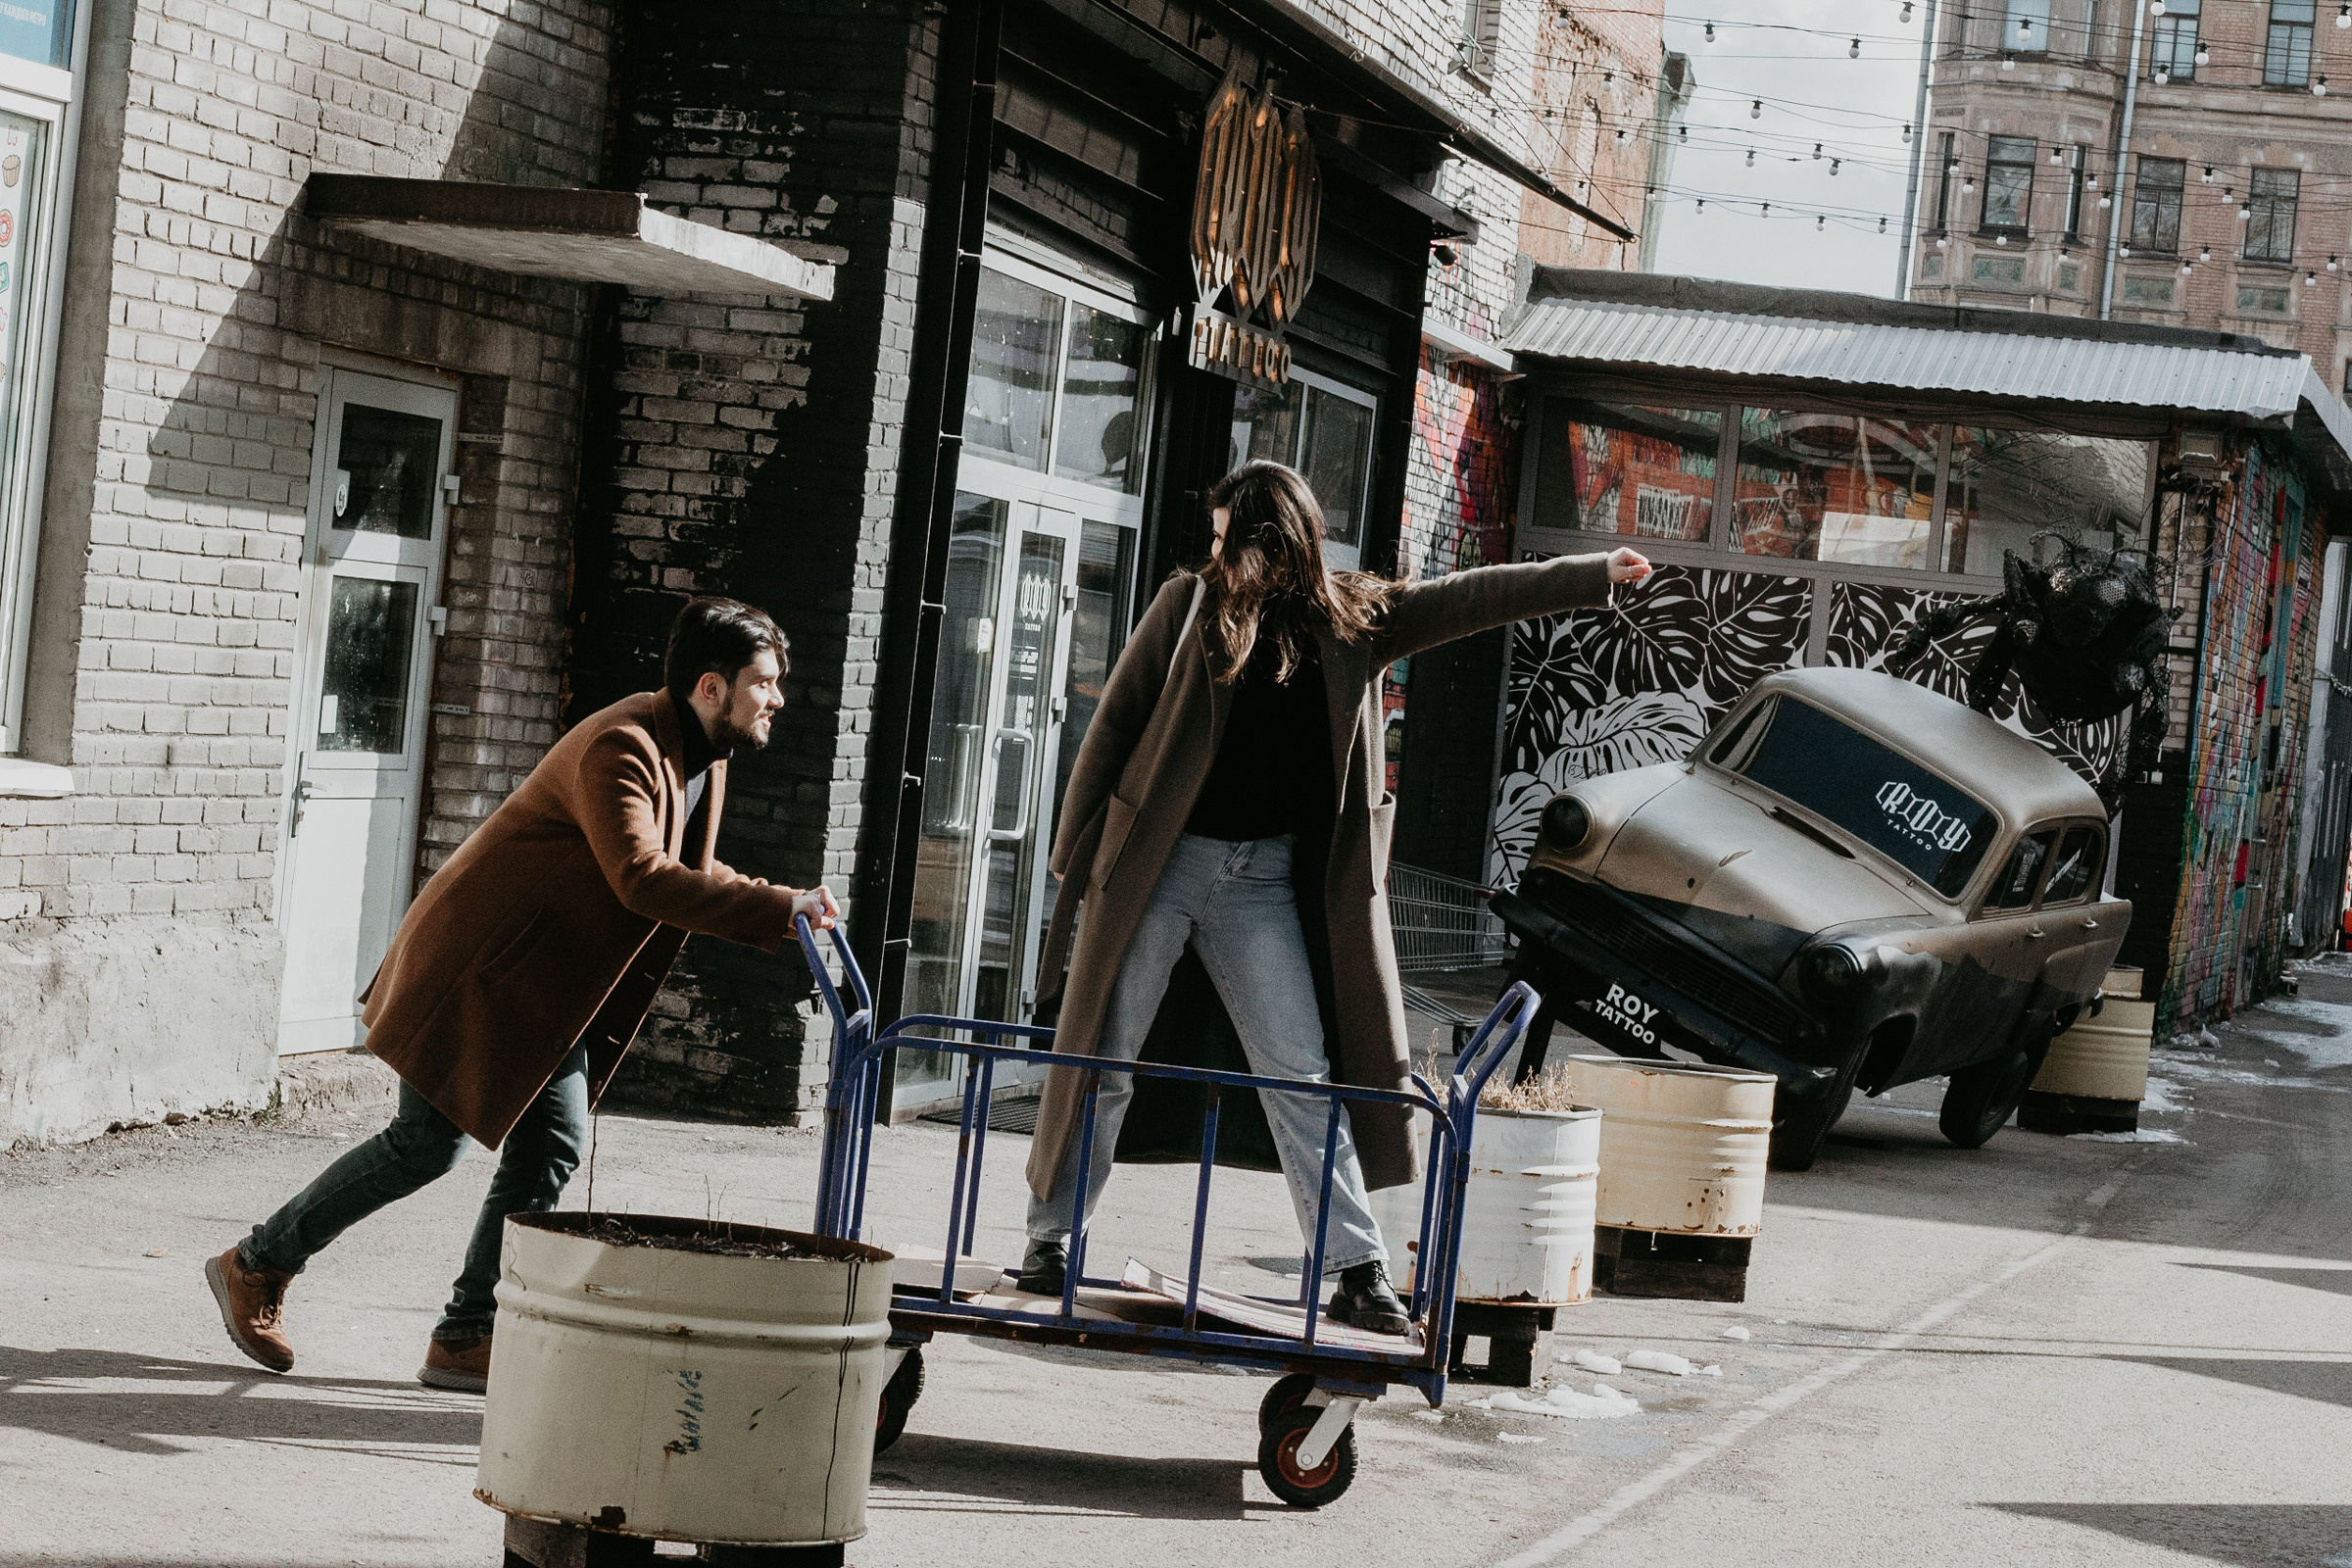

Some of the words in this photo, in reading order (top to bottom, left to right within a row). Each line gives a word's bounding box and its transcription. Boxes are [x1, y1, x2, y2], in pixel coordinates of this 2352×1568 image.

[29, 10, 47, 27] МЕТРО
[1206, 316, 1292, 384] TATTOO
[1886, 818, 1933, 851] TATTOO
[1594, 999, 1656, 1045] TATTOO
[1605, 983, 1660, 1024] ROY
